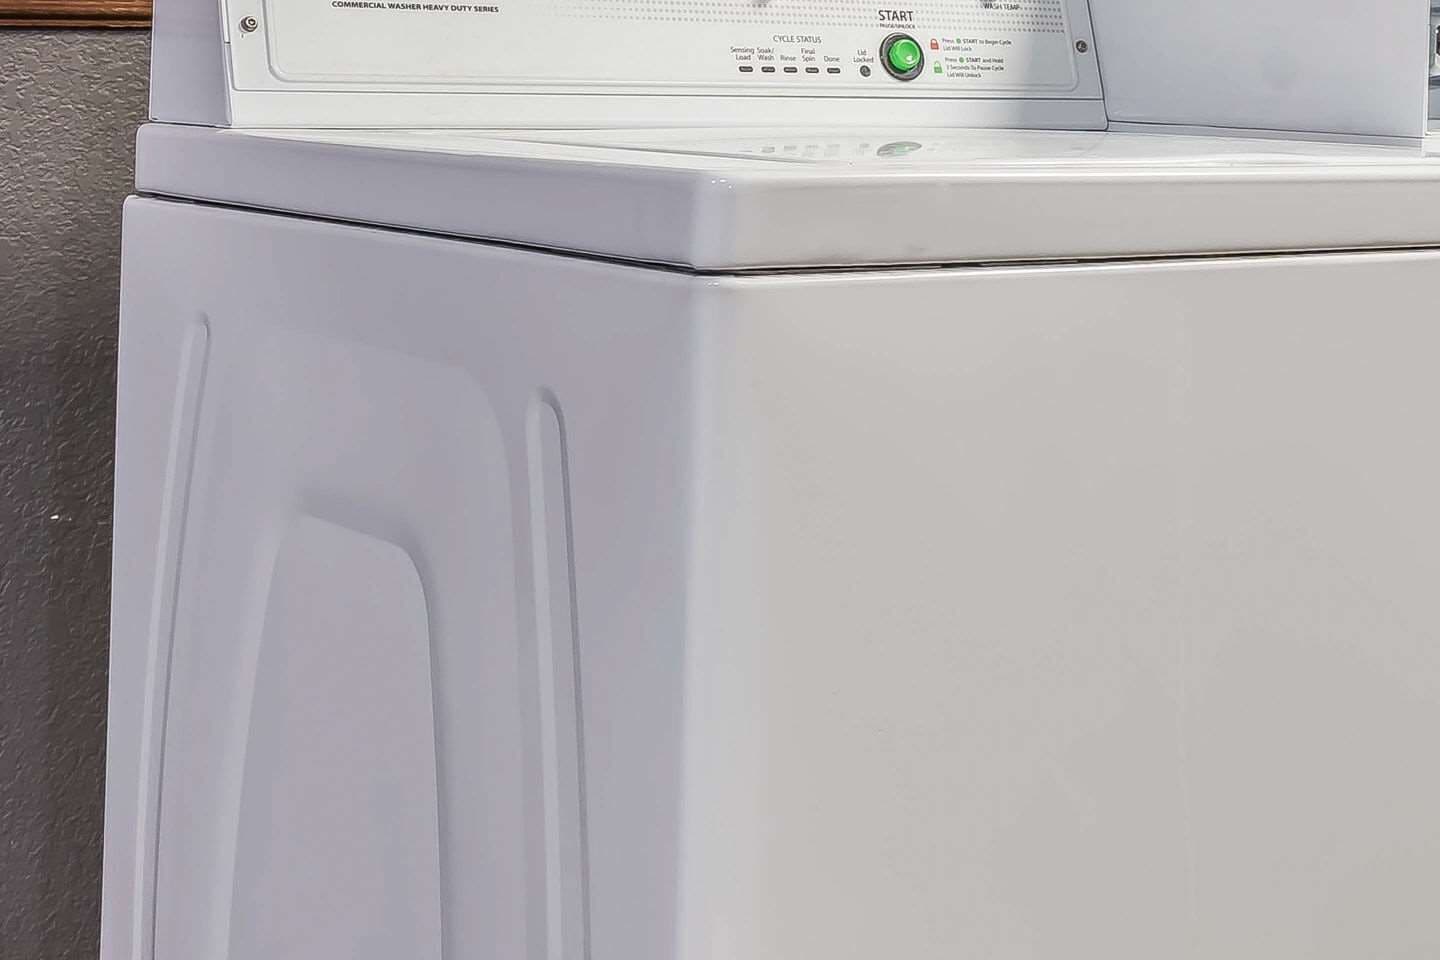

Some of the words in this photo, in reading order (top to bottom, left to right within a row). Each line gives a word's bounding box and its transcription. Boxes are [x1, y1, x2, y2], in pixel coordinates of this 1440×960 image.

[331, 0, 387, 10] COMMERCIAL
[387, 2, 422, 11] WASHER
[422, 3, 450, 12] HEAVY
[450, 4, 473, 13] DUTY
[473, 5, 499, 13] SERIES
[878, 9, 914, 22] START
[772, 35, 795, 43] CYCLE
[796, 36, 822, 44] STATUS
[730, 46, 755, 55] Sensing
[800, 47, 816, 55] Final
[801, 55, 816, 63] Spin
